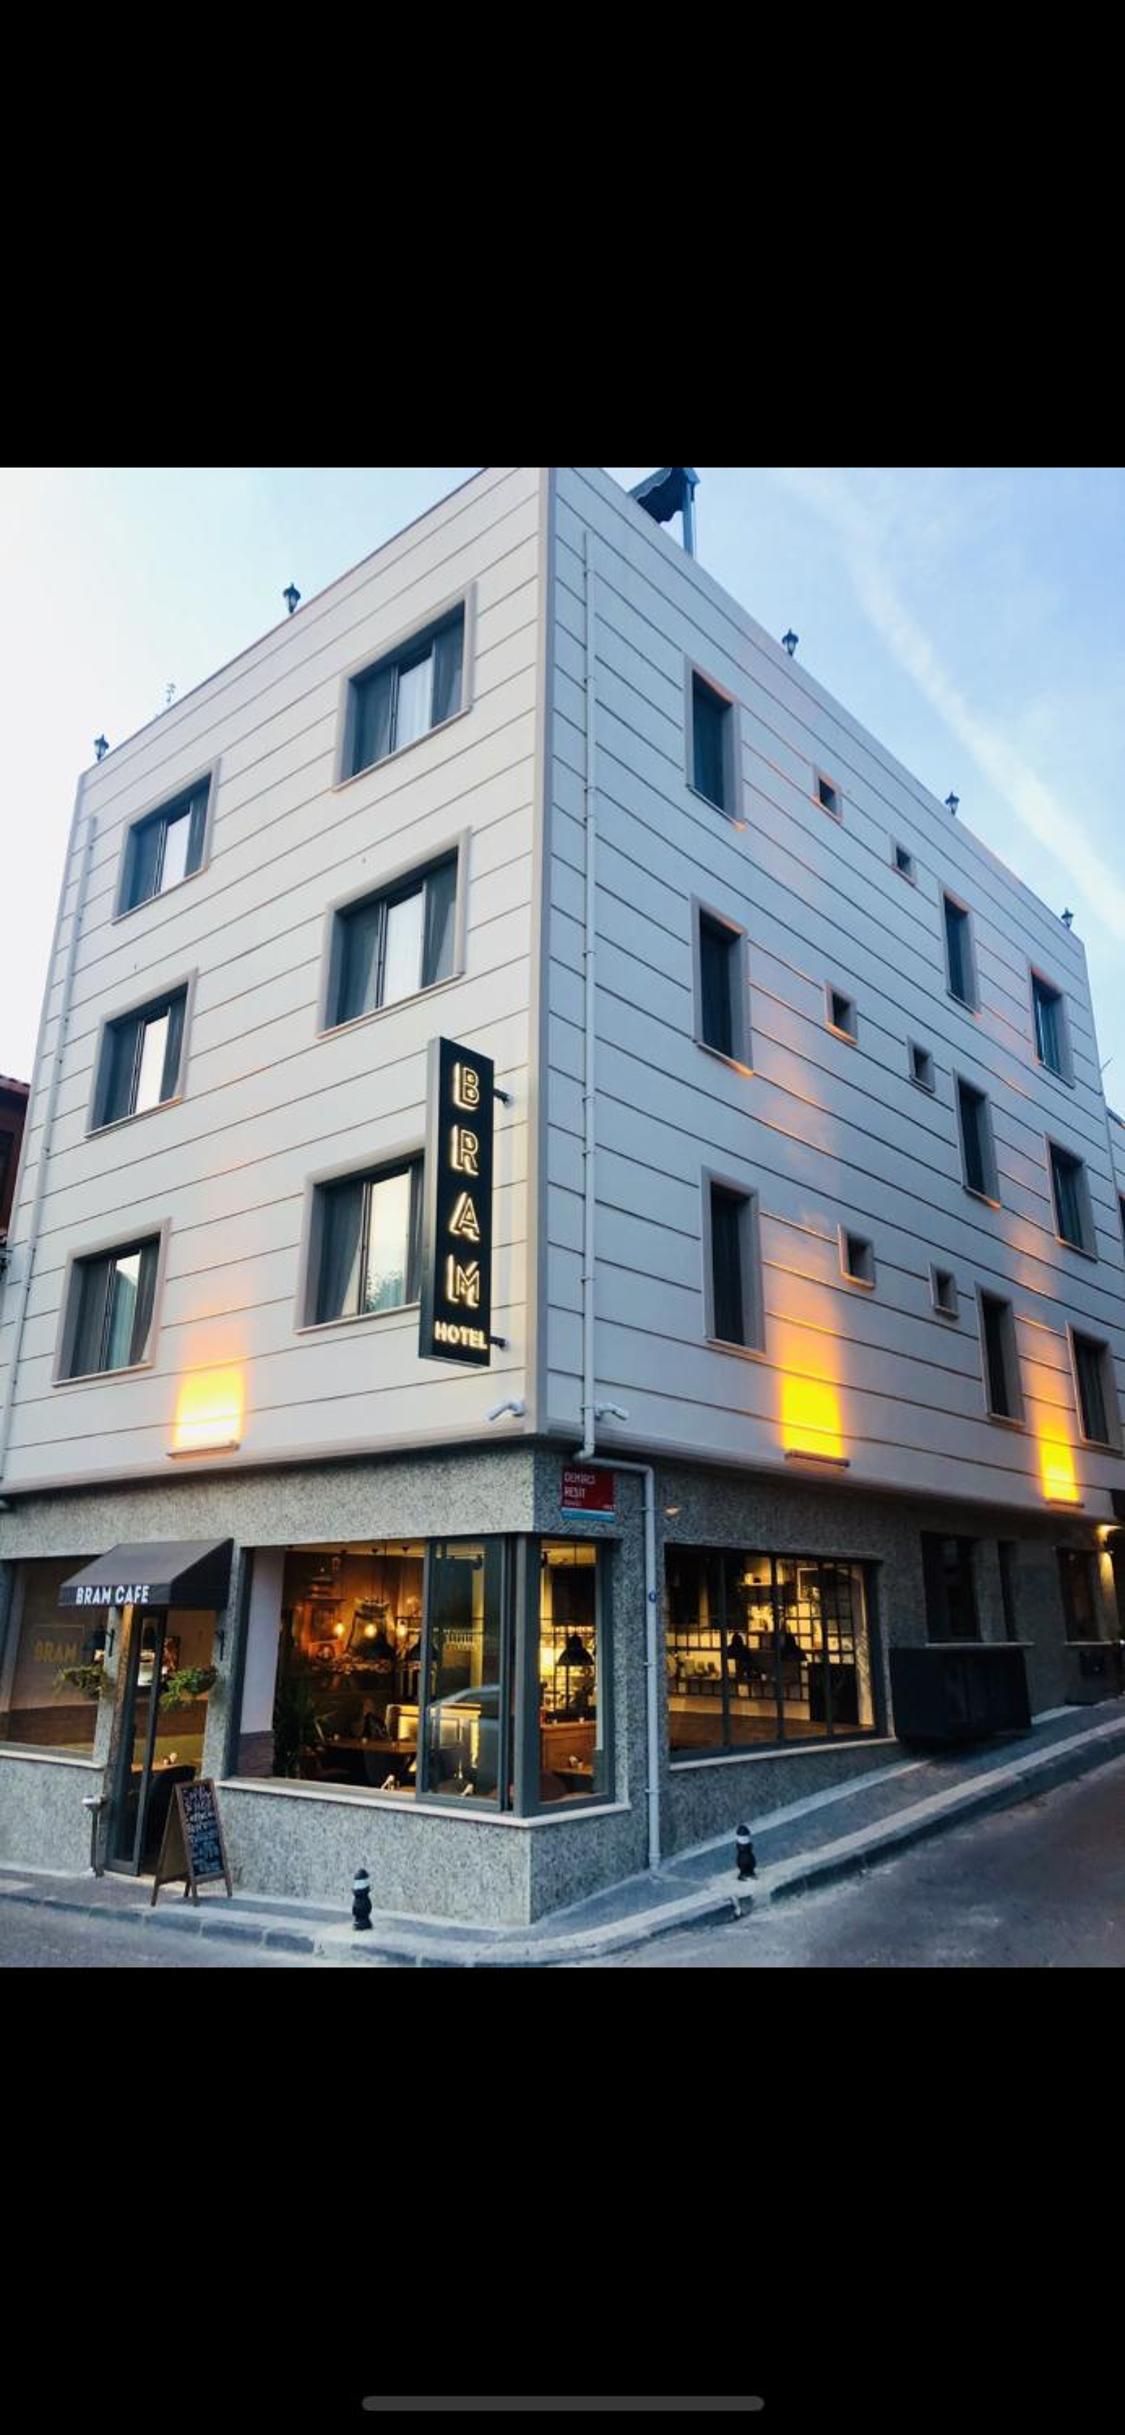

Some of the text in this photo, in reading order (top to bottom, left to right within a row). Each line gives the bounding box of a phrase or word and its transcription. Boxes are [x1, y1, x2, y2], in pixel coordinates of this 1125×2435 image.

[446, 1062, 481, 1308] BRAM
[434, 1321, 488, 1350] HOTEL
[75, 1584, 150, 1604] BRAM CAFE
[35, 1640, 78, 1663] BRAM
